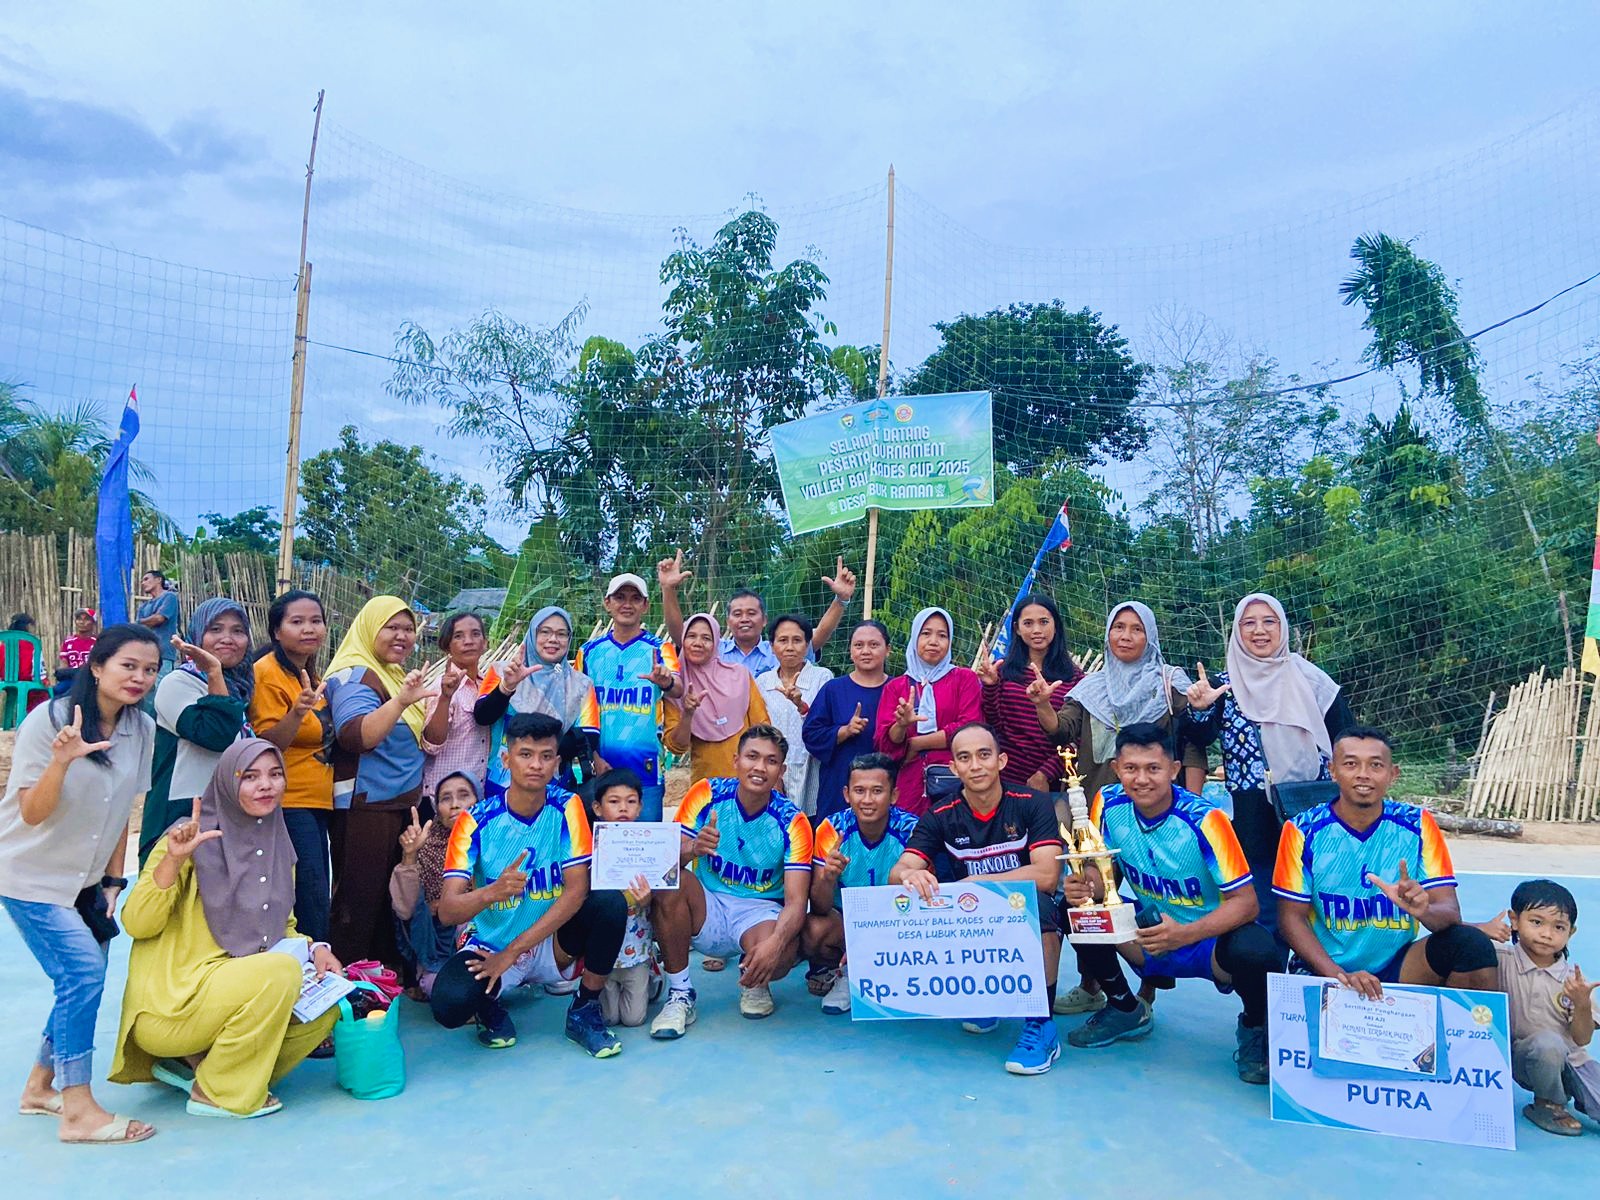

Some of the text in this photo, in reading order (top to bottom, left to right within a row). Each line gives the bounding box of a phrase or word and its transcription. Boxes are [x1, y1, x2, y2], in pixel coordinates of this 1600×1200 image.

[883, 426, 929, 442] DATANG
[818, 442, 945, 476] PESERTA OURNAMENT
[800, 476, 845, 500] VOLLEY
[870, 460, 906, 478] KADES
[910, 461, 934, 478] CUP
[936, 460, 970, 476] 2025
[838, 493, 866, 512] DESA
[890, 483, 934, 499] RAMAN
[594, 685, 653, 715] RAVOLB
[525, 847, 537, 869] 2
[964, 853, 1019, 875] TRAVOLB
[1361, 863, 1374, 889] 6
[852, 914, 1028, 929] TURNAMENT VOLLY BALL KADES CUP 2025
[897, 928, 994, 940] DESA LUBUK RAMAN
[873, 948, 1025, 967] JUARA 1 PUTRA
[859, 974, 1033, 1003] Rp. 5.000.000
[1280, 1012, 1493, 1040] TURN CUP 2025
[1279, 1048, 1312, 1069] PE
[1347, 1083, 1432, 1111] PUTRA
